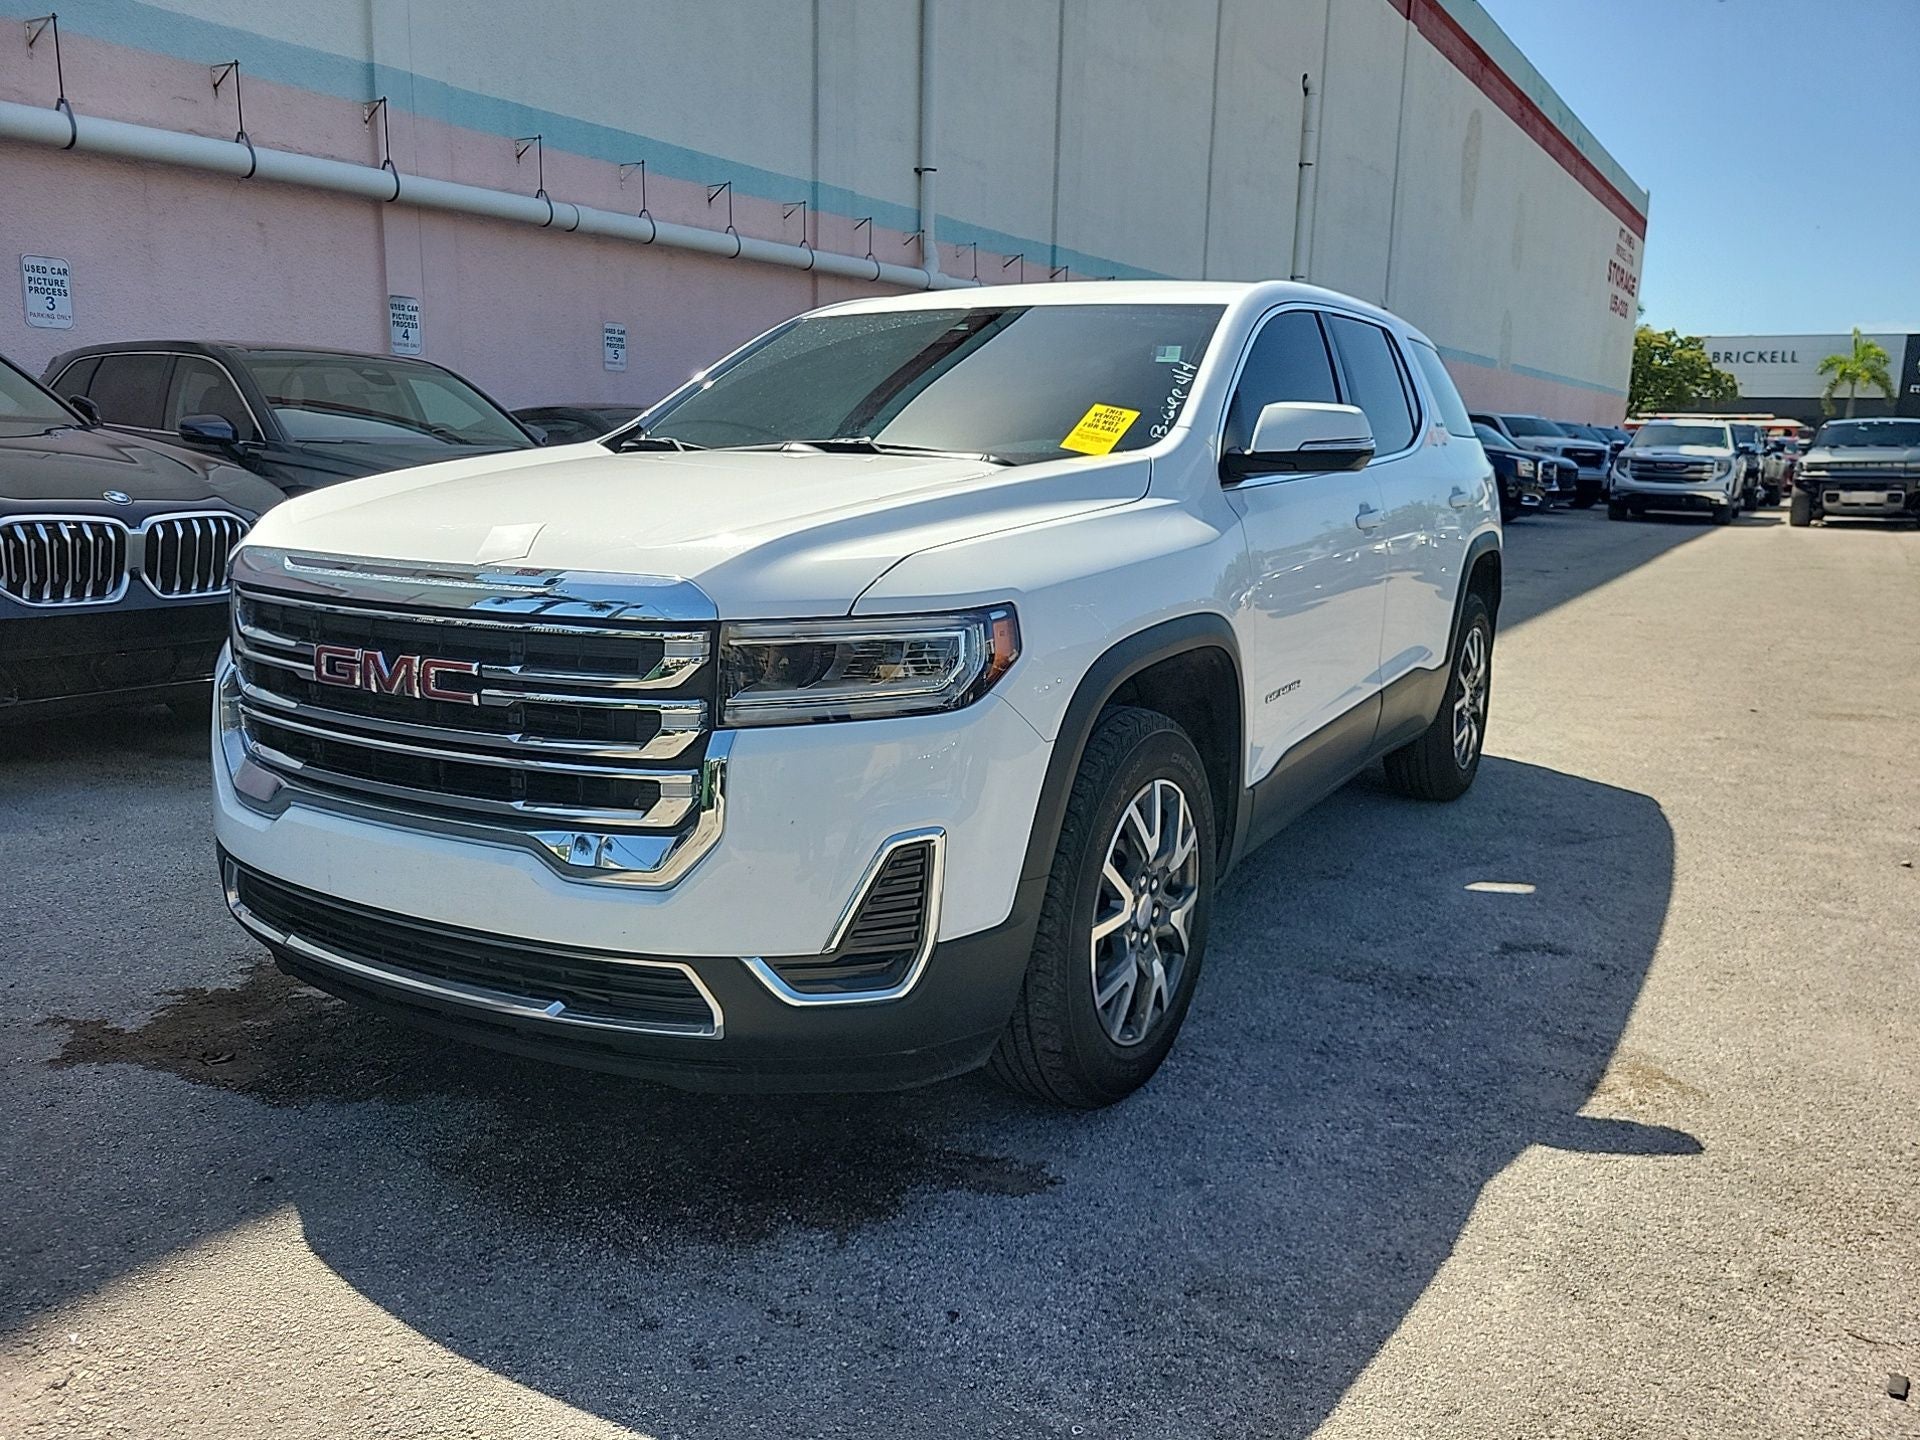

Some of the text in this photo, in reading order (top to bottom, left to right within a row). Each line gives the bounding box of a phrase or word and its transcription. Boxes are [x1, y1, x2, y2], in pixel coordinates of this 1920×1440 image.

[24, 264, 68, 276] USED CAR
[28, 276, 65, 287] PICTURE
[28, 286, 68, 297] PROCESS
[45, 296, 56, 311] 3
[390, 303, 419, 312] USED CAR
[392, 312, 417, 321] PICTURE
[392, 320, 418, 329] PROCESS
[402, 328, 410, 340] 4
[613, 349, 619, 360] 5
[1711, 350, 1799, 363] BRICKELL
[1094, 412, 1126, 422] VEHICLE
[1105, 408, 1124, 416] THIS
[1100, 425, 1120, 434] SALE
[1102, 420, 1120, 428] NOT
[314, 644, 480, 707] GMC
